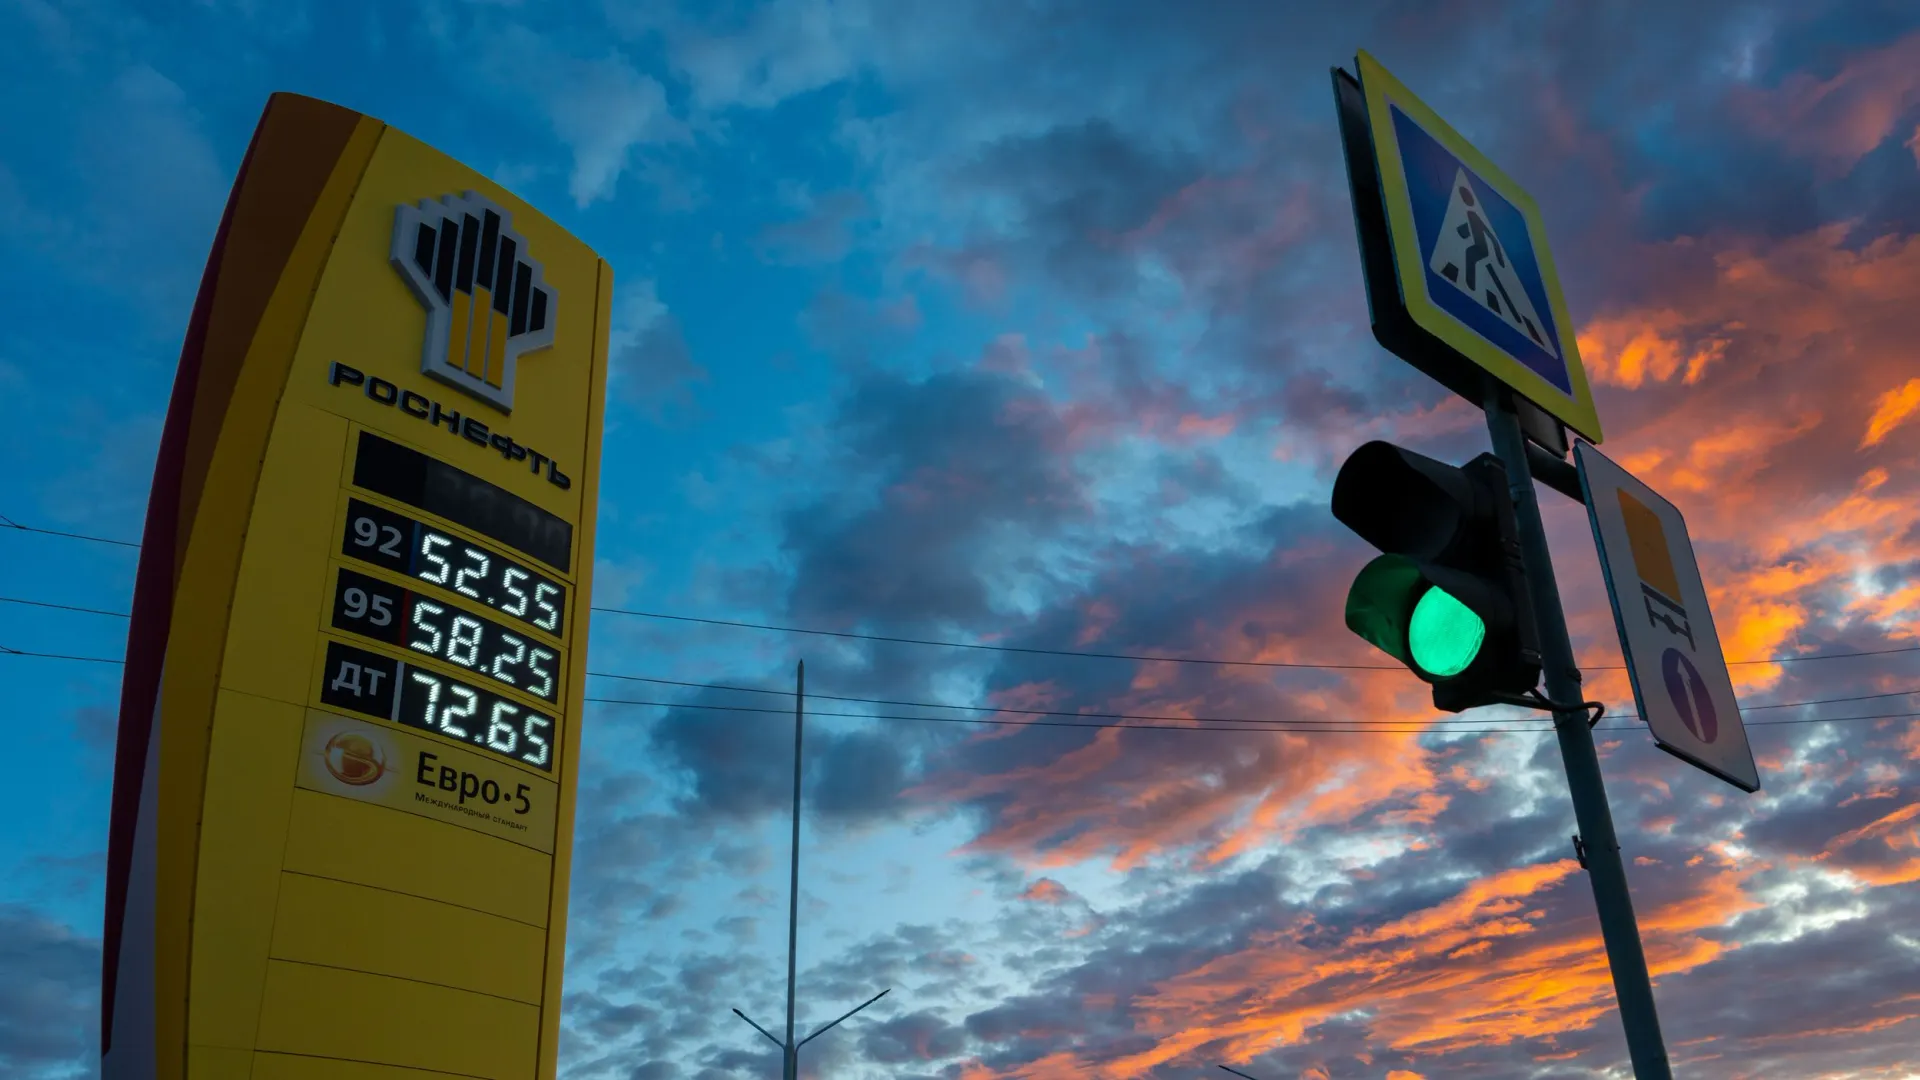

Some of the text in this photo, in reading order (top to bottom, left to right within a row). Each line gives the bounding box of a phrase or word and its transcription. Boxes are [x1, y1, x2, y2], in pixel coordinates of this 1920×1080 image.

[329, 361, 572, 490] РОСНЕФТЬ
[353, 517, 560, 630] 92 52.55
[343, 587, 553, 697] 95 58.25
[331, 661, 549, 765] ДТ 72.65
